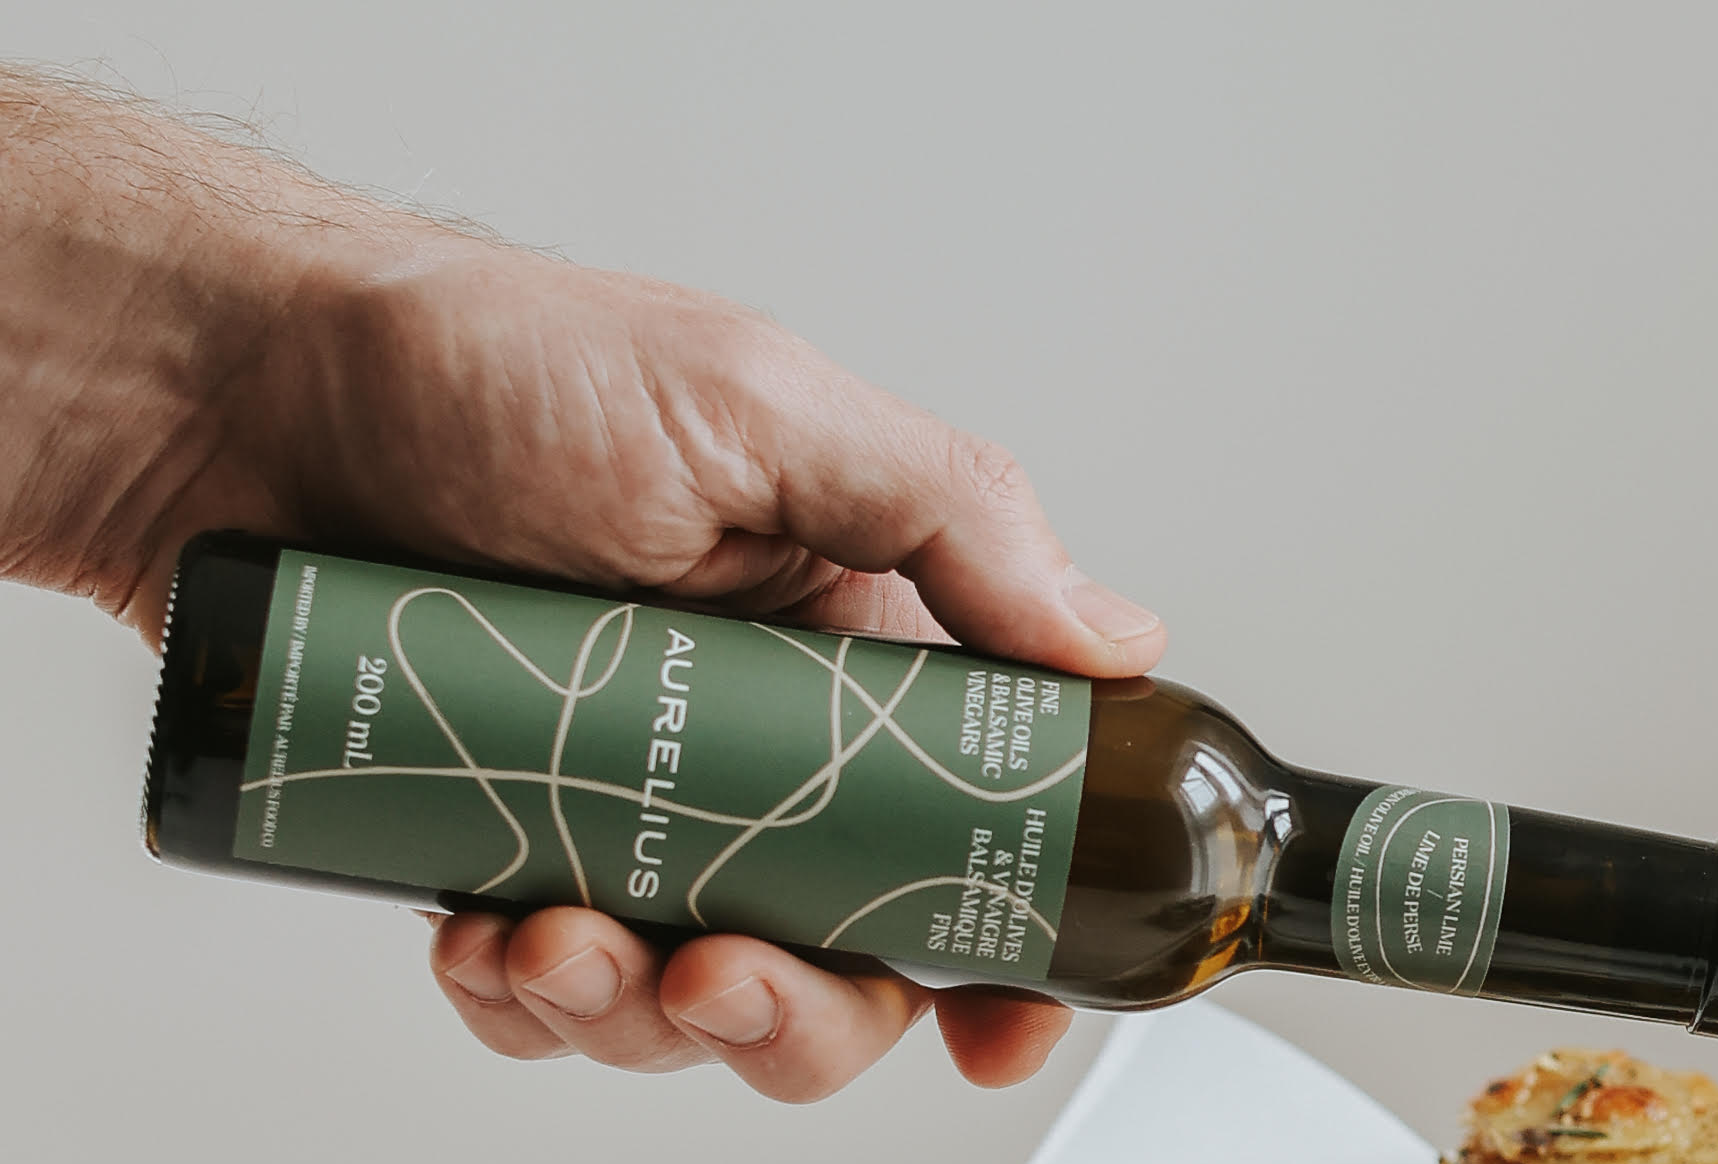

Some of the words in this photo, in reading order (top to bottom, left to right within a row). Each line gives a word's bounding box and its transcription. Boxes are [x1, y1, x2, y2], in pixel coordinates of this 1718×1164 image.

[352, 654, 387, 716] 200
[991, 673, 1011, 684] &
[1013, 677, 1035, 723] OLIVE
[1040, 680, 1060, 715] FINE
[960, 670, 986, 756] VINEGARS
[981, 685, 1011, 779] BALSAMIC
[343, 720, 373, 768] mL
[627, 628, 696, 898] AURELIUS
[1008, 725, 1031, 771] OILS
[1364, 801, 1391, 835] OLIVE
[994, 850, 1014, 866] &
[1018, 808, 1046, 877] HUILE
[1355, 834, 1373, 857] OIL
[1411, 830, 1440, 871] LIME
[952, 828, 992, 954] BALSAMIQUE
[1347, 867, 1364, 913] HUILE
[1405, 872, 1424, 898] DE
[1446, 837, 1469, 912] PERSIAN
[927, 913, 952, 950] FINS
[976, 871, 1011, 958] VINAIGRE
[1002, 880, 1035, 962] D'OLIVES
[1403, 901, 1423, 954] PERSE
[1436, 915, 1458, 955] LIME
[1346, 916, 1366, 962] D'OLIVE
